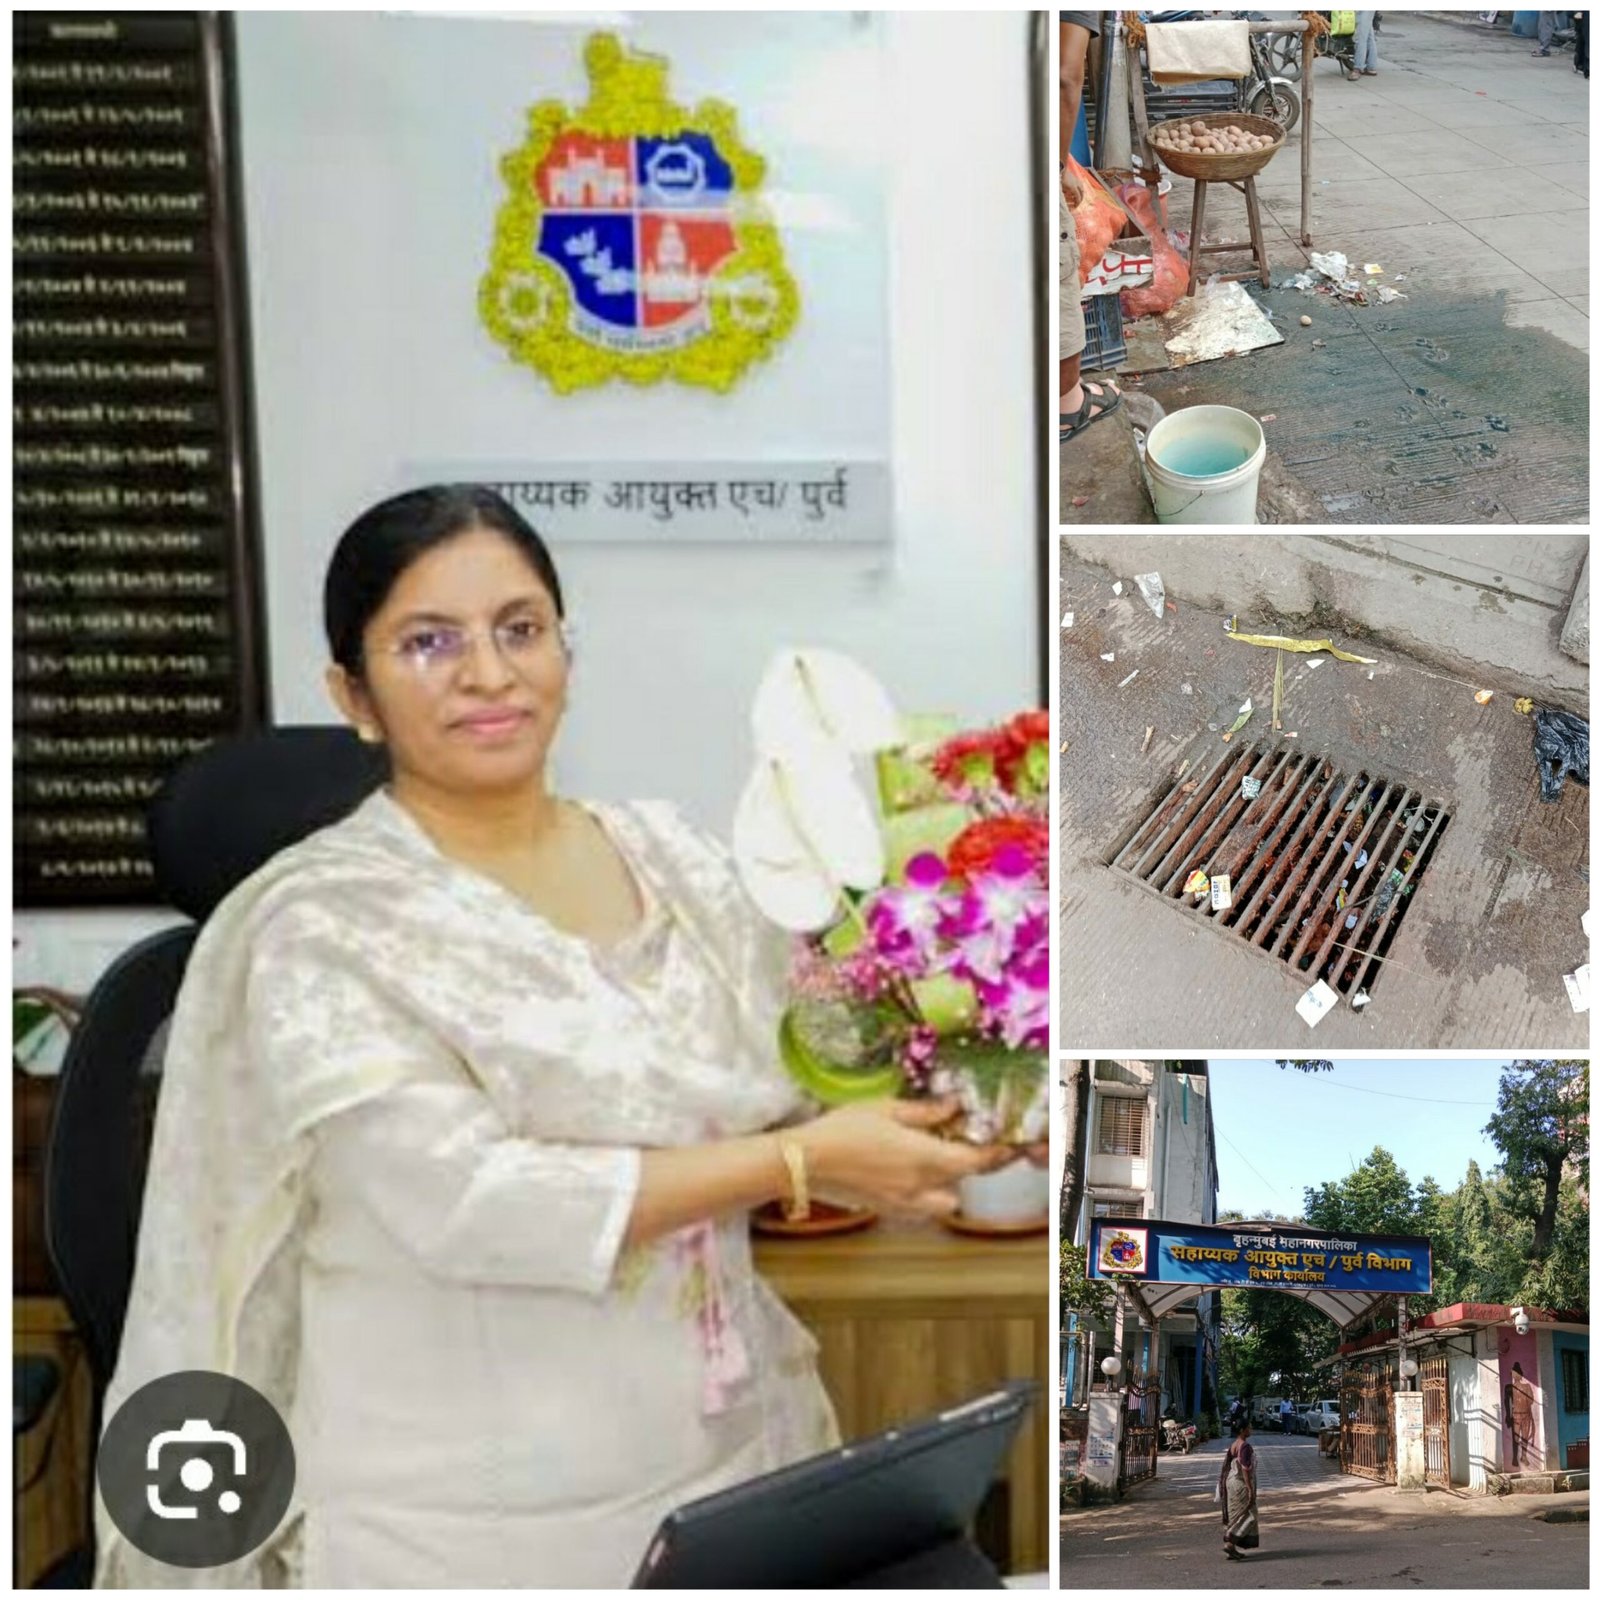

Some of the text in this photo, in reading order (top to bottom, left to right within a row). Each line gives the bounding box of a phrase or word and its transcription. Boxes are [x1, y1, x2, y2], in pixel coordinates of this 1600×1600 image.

[603, 480, 718, 521] आयुक्त
[799, 466, 848, 521] पुर्व
[1279, 1234, 1358, 1251] महानगरपालिका
[1170, 1245, 1239, 1262] सहाय्यक
[1244, 1249, 1298, 1267] आयुक्त
[1301, 1253, 1326, 1269] एच
[1328, 1255, 1338, 1269] /
[1366, 1252, 1412, 1271] विभाग
[1248, 1266, 1326, 1281] विभाग कार्यालय
